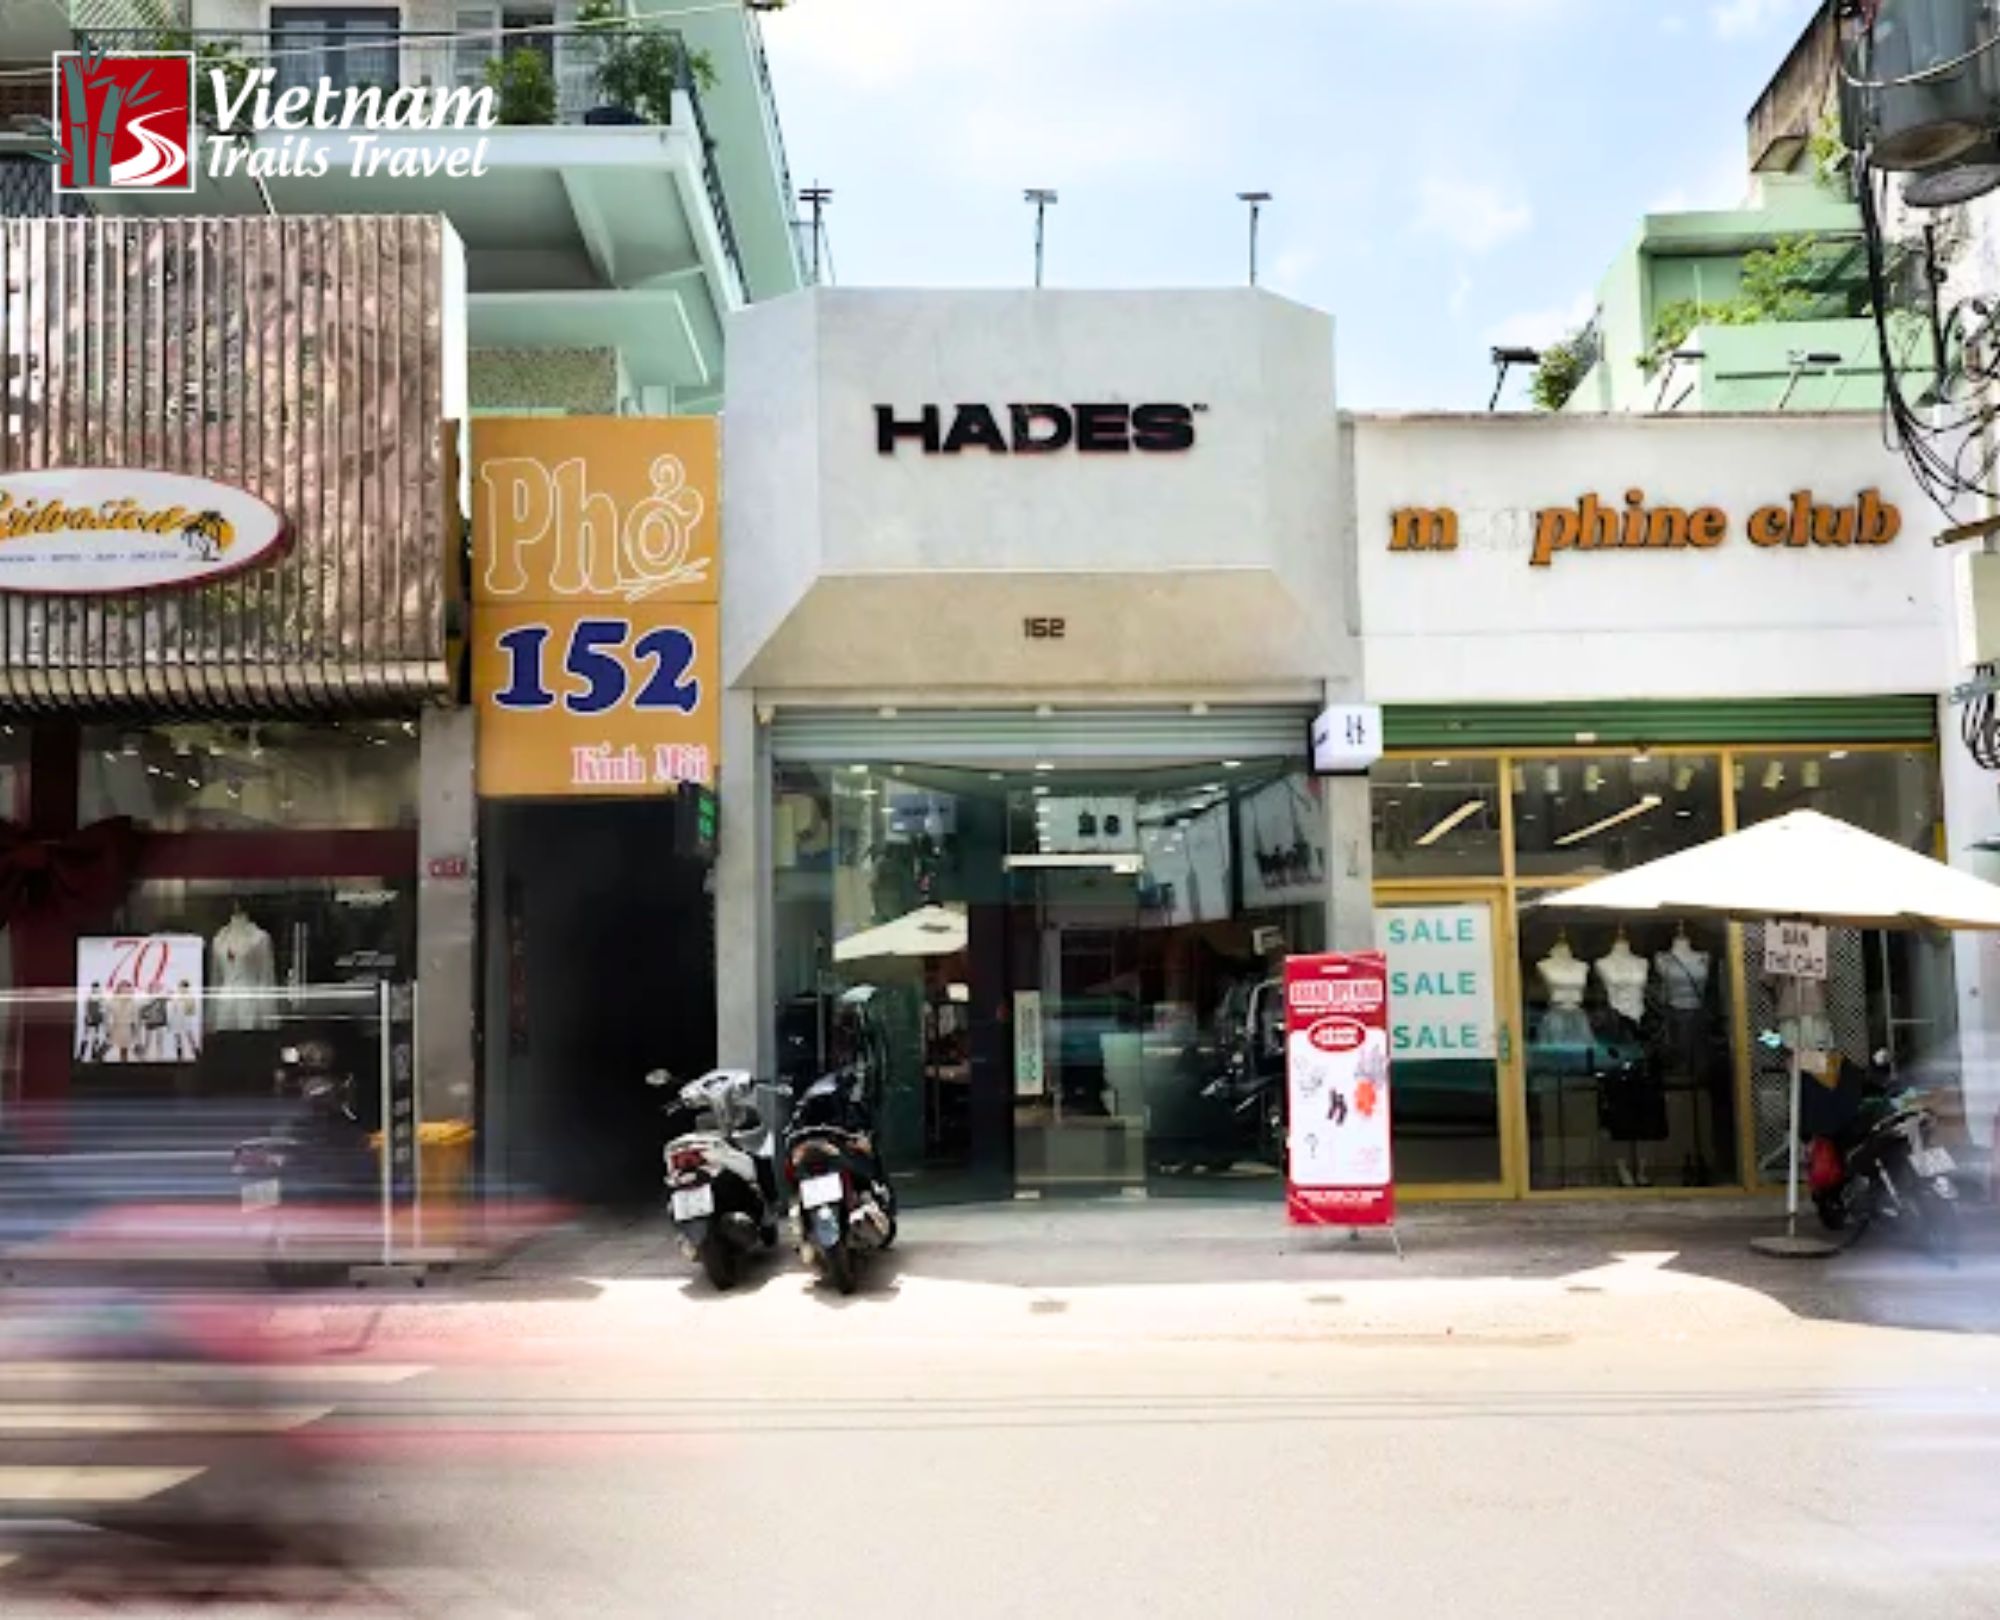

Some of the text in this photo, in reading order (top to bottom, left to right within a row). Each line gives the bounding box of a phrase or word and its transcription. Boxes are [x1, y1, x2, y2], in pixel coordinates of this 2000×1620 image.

[872, 401, 1196, 456] HADES
[481, 453, 704, 595] Phở
[1747, 488, 1902, 548] club
[1024, 617, 1066, 638] 152
[494, 617, 699, 714] 152
[1388, 917, 1475, 944] SALE
[1391, 971, 1477, 995] SALE
[1392, 1024, 1480, 1050] SALE
